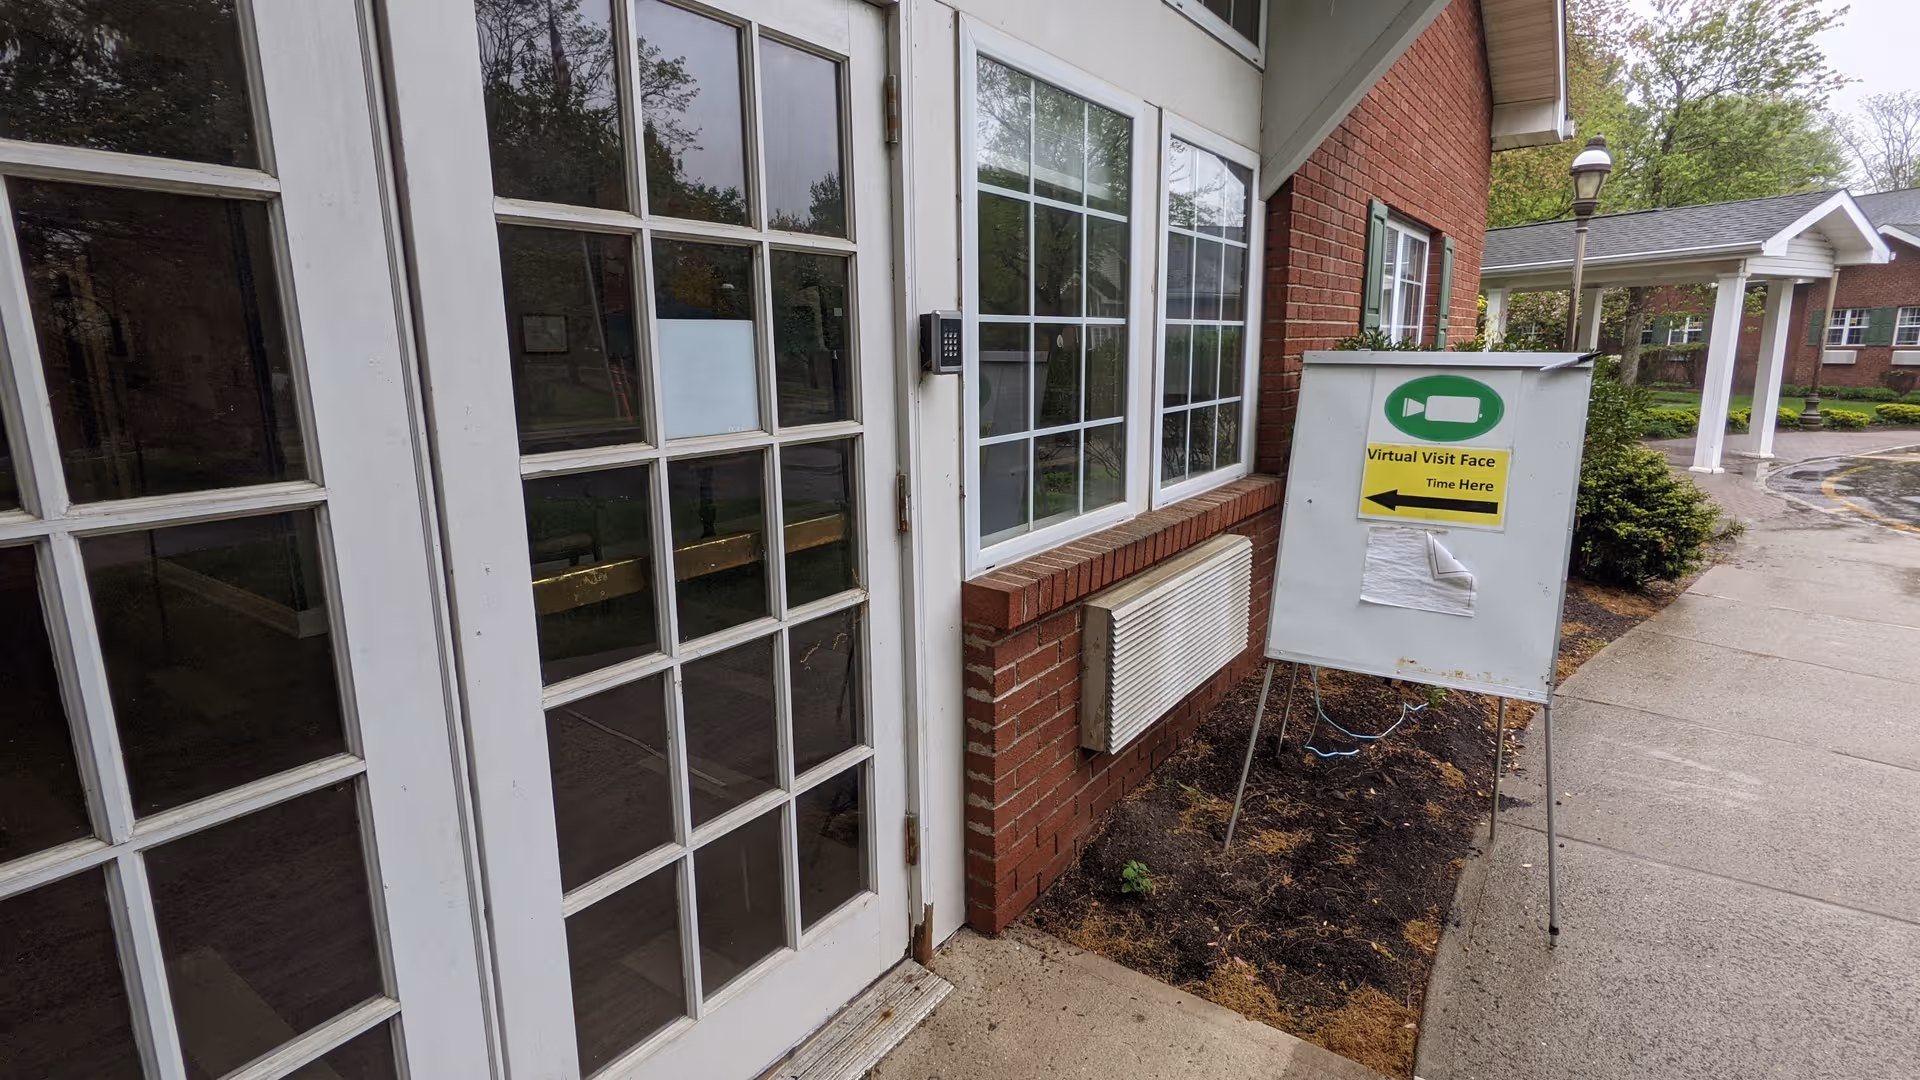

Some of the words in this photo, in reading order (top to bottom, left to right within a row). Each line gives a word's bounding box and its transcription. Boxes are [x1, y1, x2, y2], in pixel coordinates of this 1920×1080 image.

[1367, 448, 1417, 463] Virtual
[1422, 451, 1456, 465] Visit
[1460, 453, 1496, 468] Face
[1426, 478, 1456, 489] Time
[1459, 479, 1494, 492] Here
